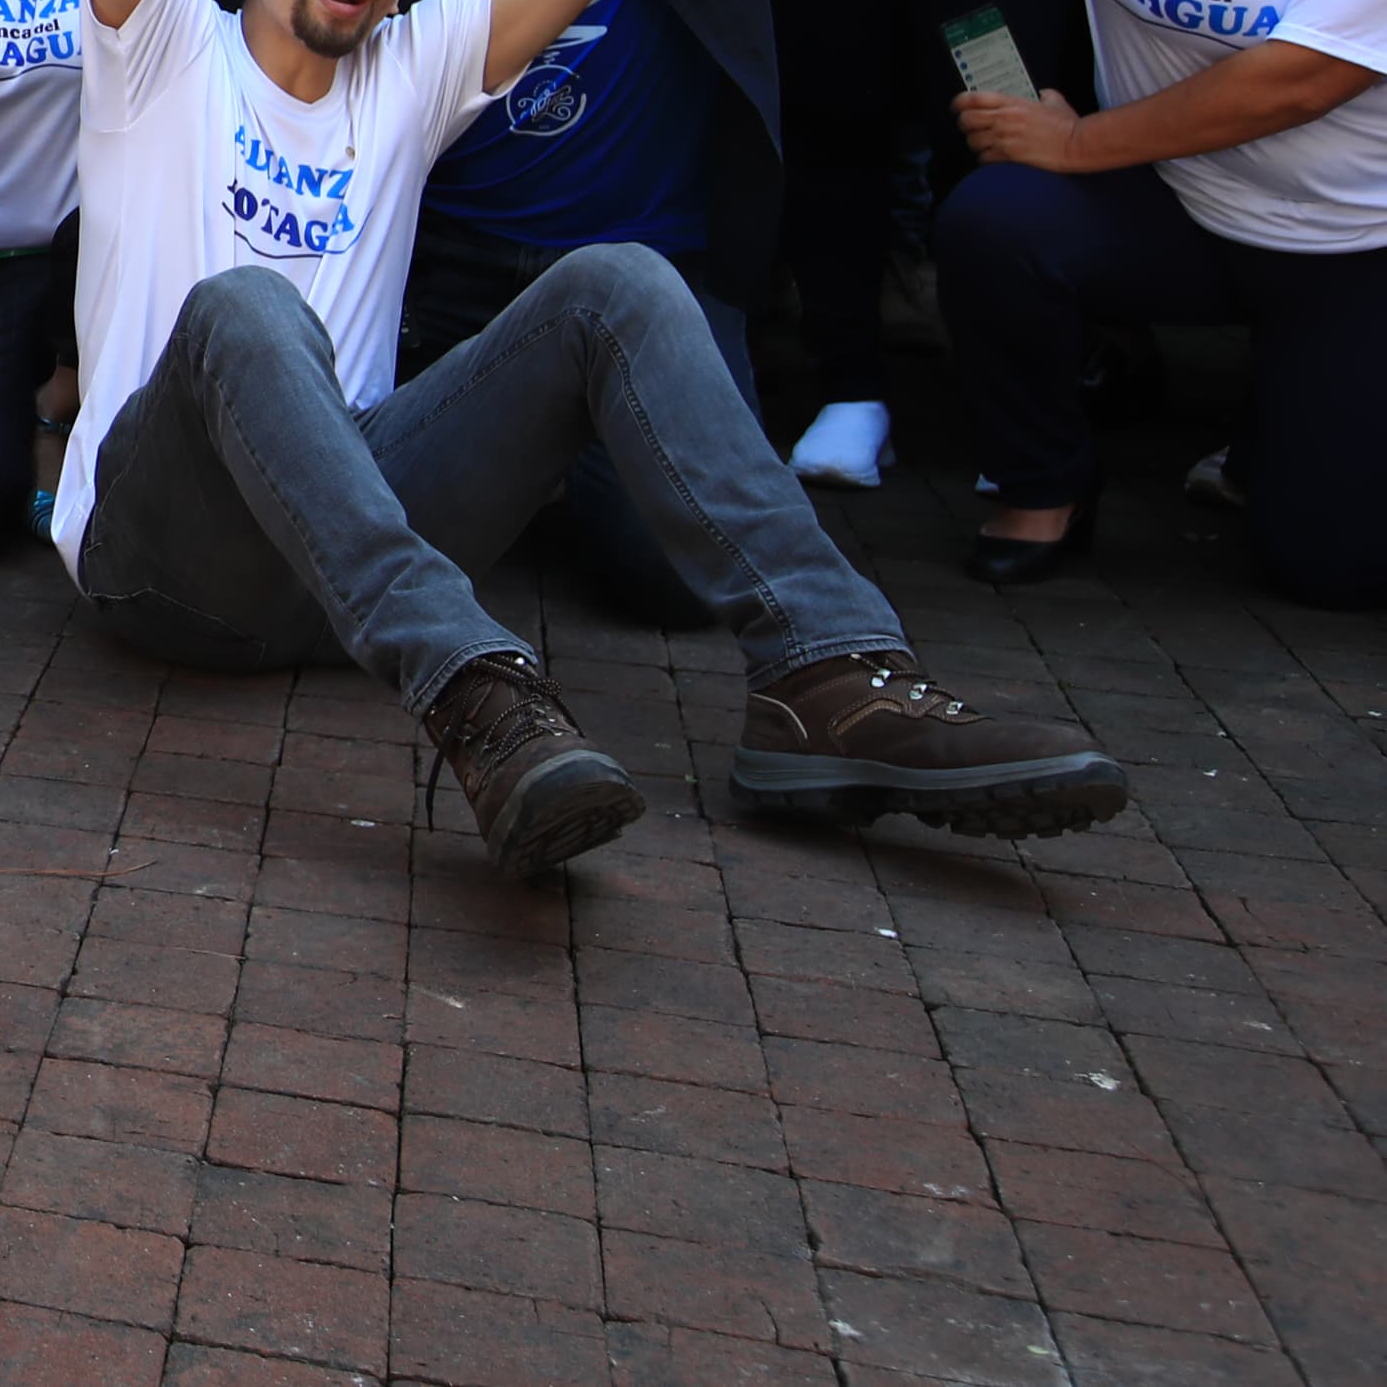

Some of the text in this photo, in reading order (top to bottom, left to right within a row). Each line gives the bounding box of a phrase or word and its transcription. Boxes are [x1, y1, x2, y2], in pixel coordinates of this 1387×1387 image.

[34, 18, 60, 35] del
[235, 125, 355, 199] ALIANZ
[227, 178, 355, 253] OTAGA
